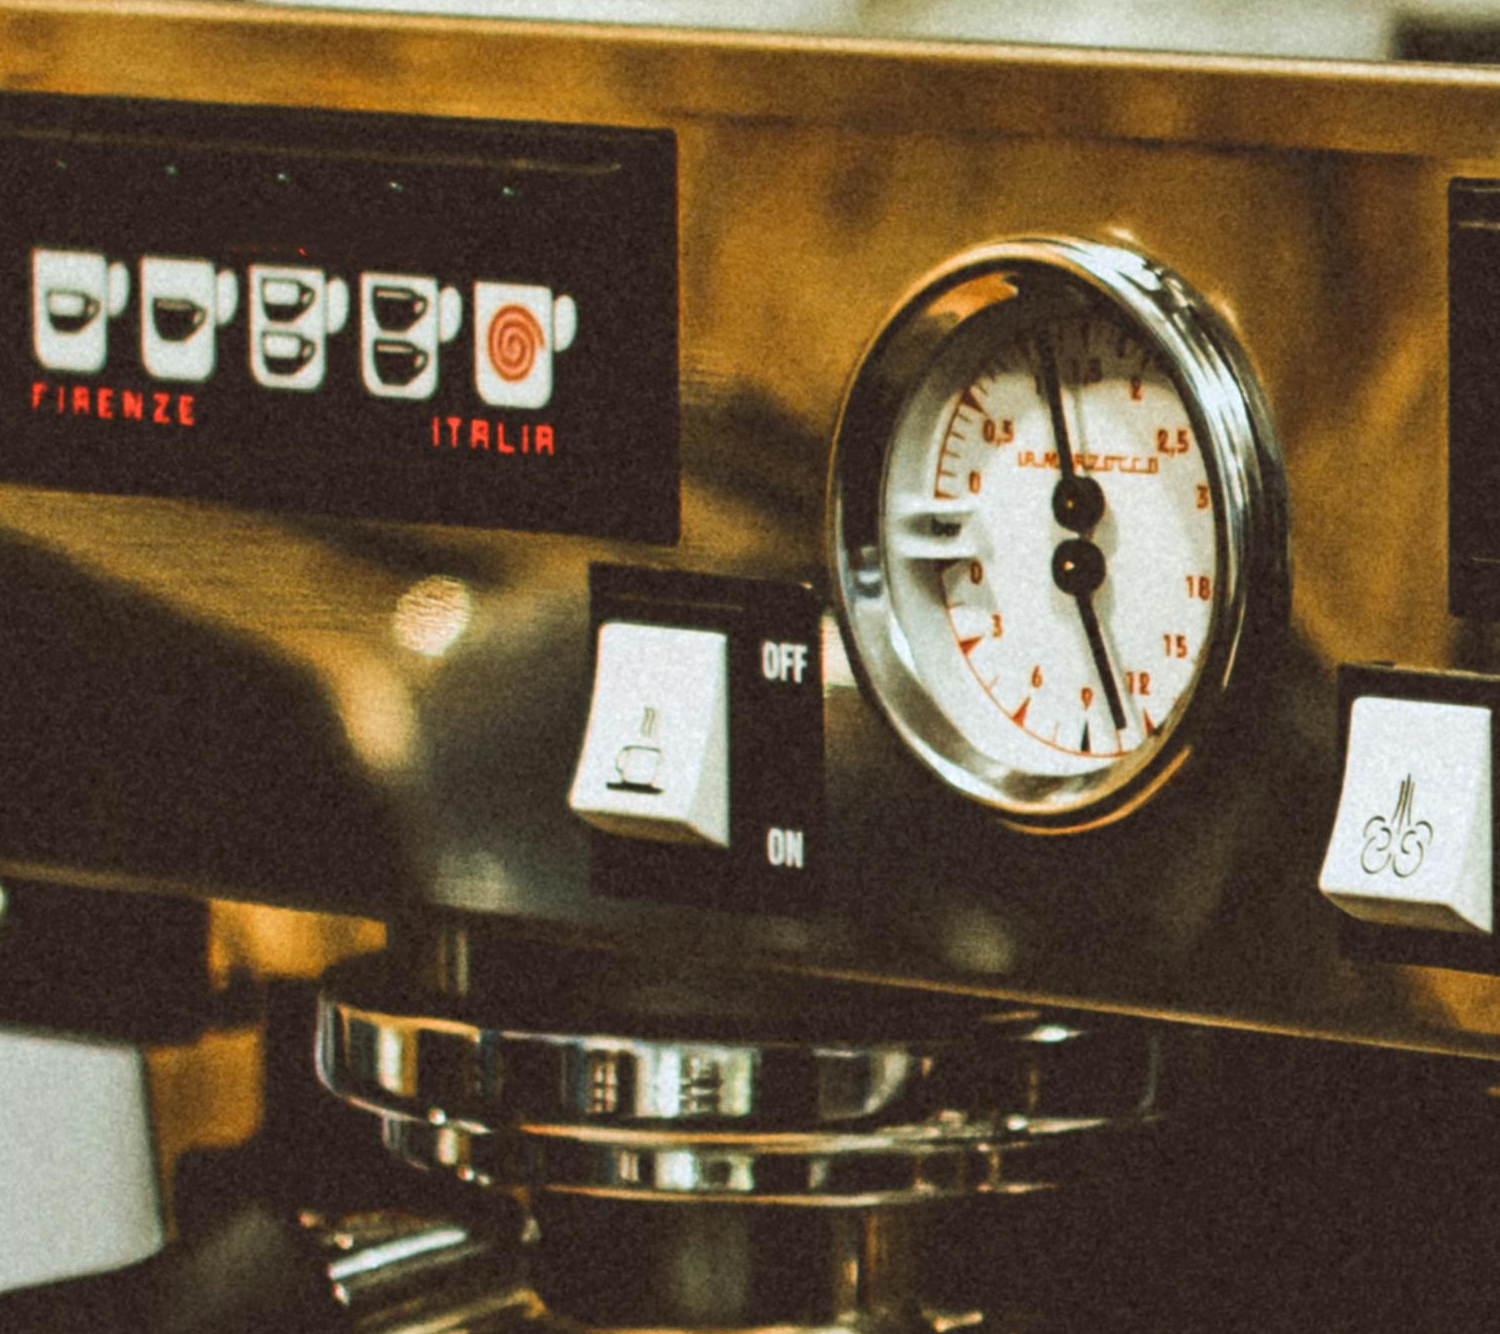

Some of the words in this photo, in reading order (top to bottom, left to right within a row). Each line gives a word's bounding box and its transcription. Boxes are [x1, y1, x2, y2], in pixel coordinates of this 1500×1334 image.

[31, 381, 196, 427] FIRENZE
[432, 415, 556, 457] ITALIA
[983, 418, 1014, 447] 0,5
[1156, 428, 1190, 457] 2,5
[968, 469, 981, 495] 0
[1196, 484, 1209, 509] 3
[969, 559, 983, 585] 0
[1186, 575, 1211, 601] 18
[991, 614, 1003, 638] 3
[1163, 634, 1188, 659] 15
[762, 640, 808, 683] OFF
[1030, 665, 1043, 689] 6
[1126, 671, 1150, 696] 12
[1080, 687, 1093, 711] 9
[767, 827, 804, 868] ON
